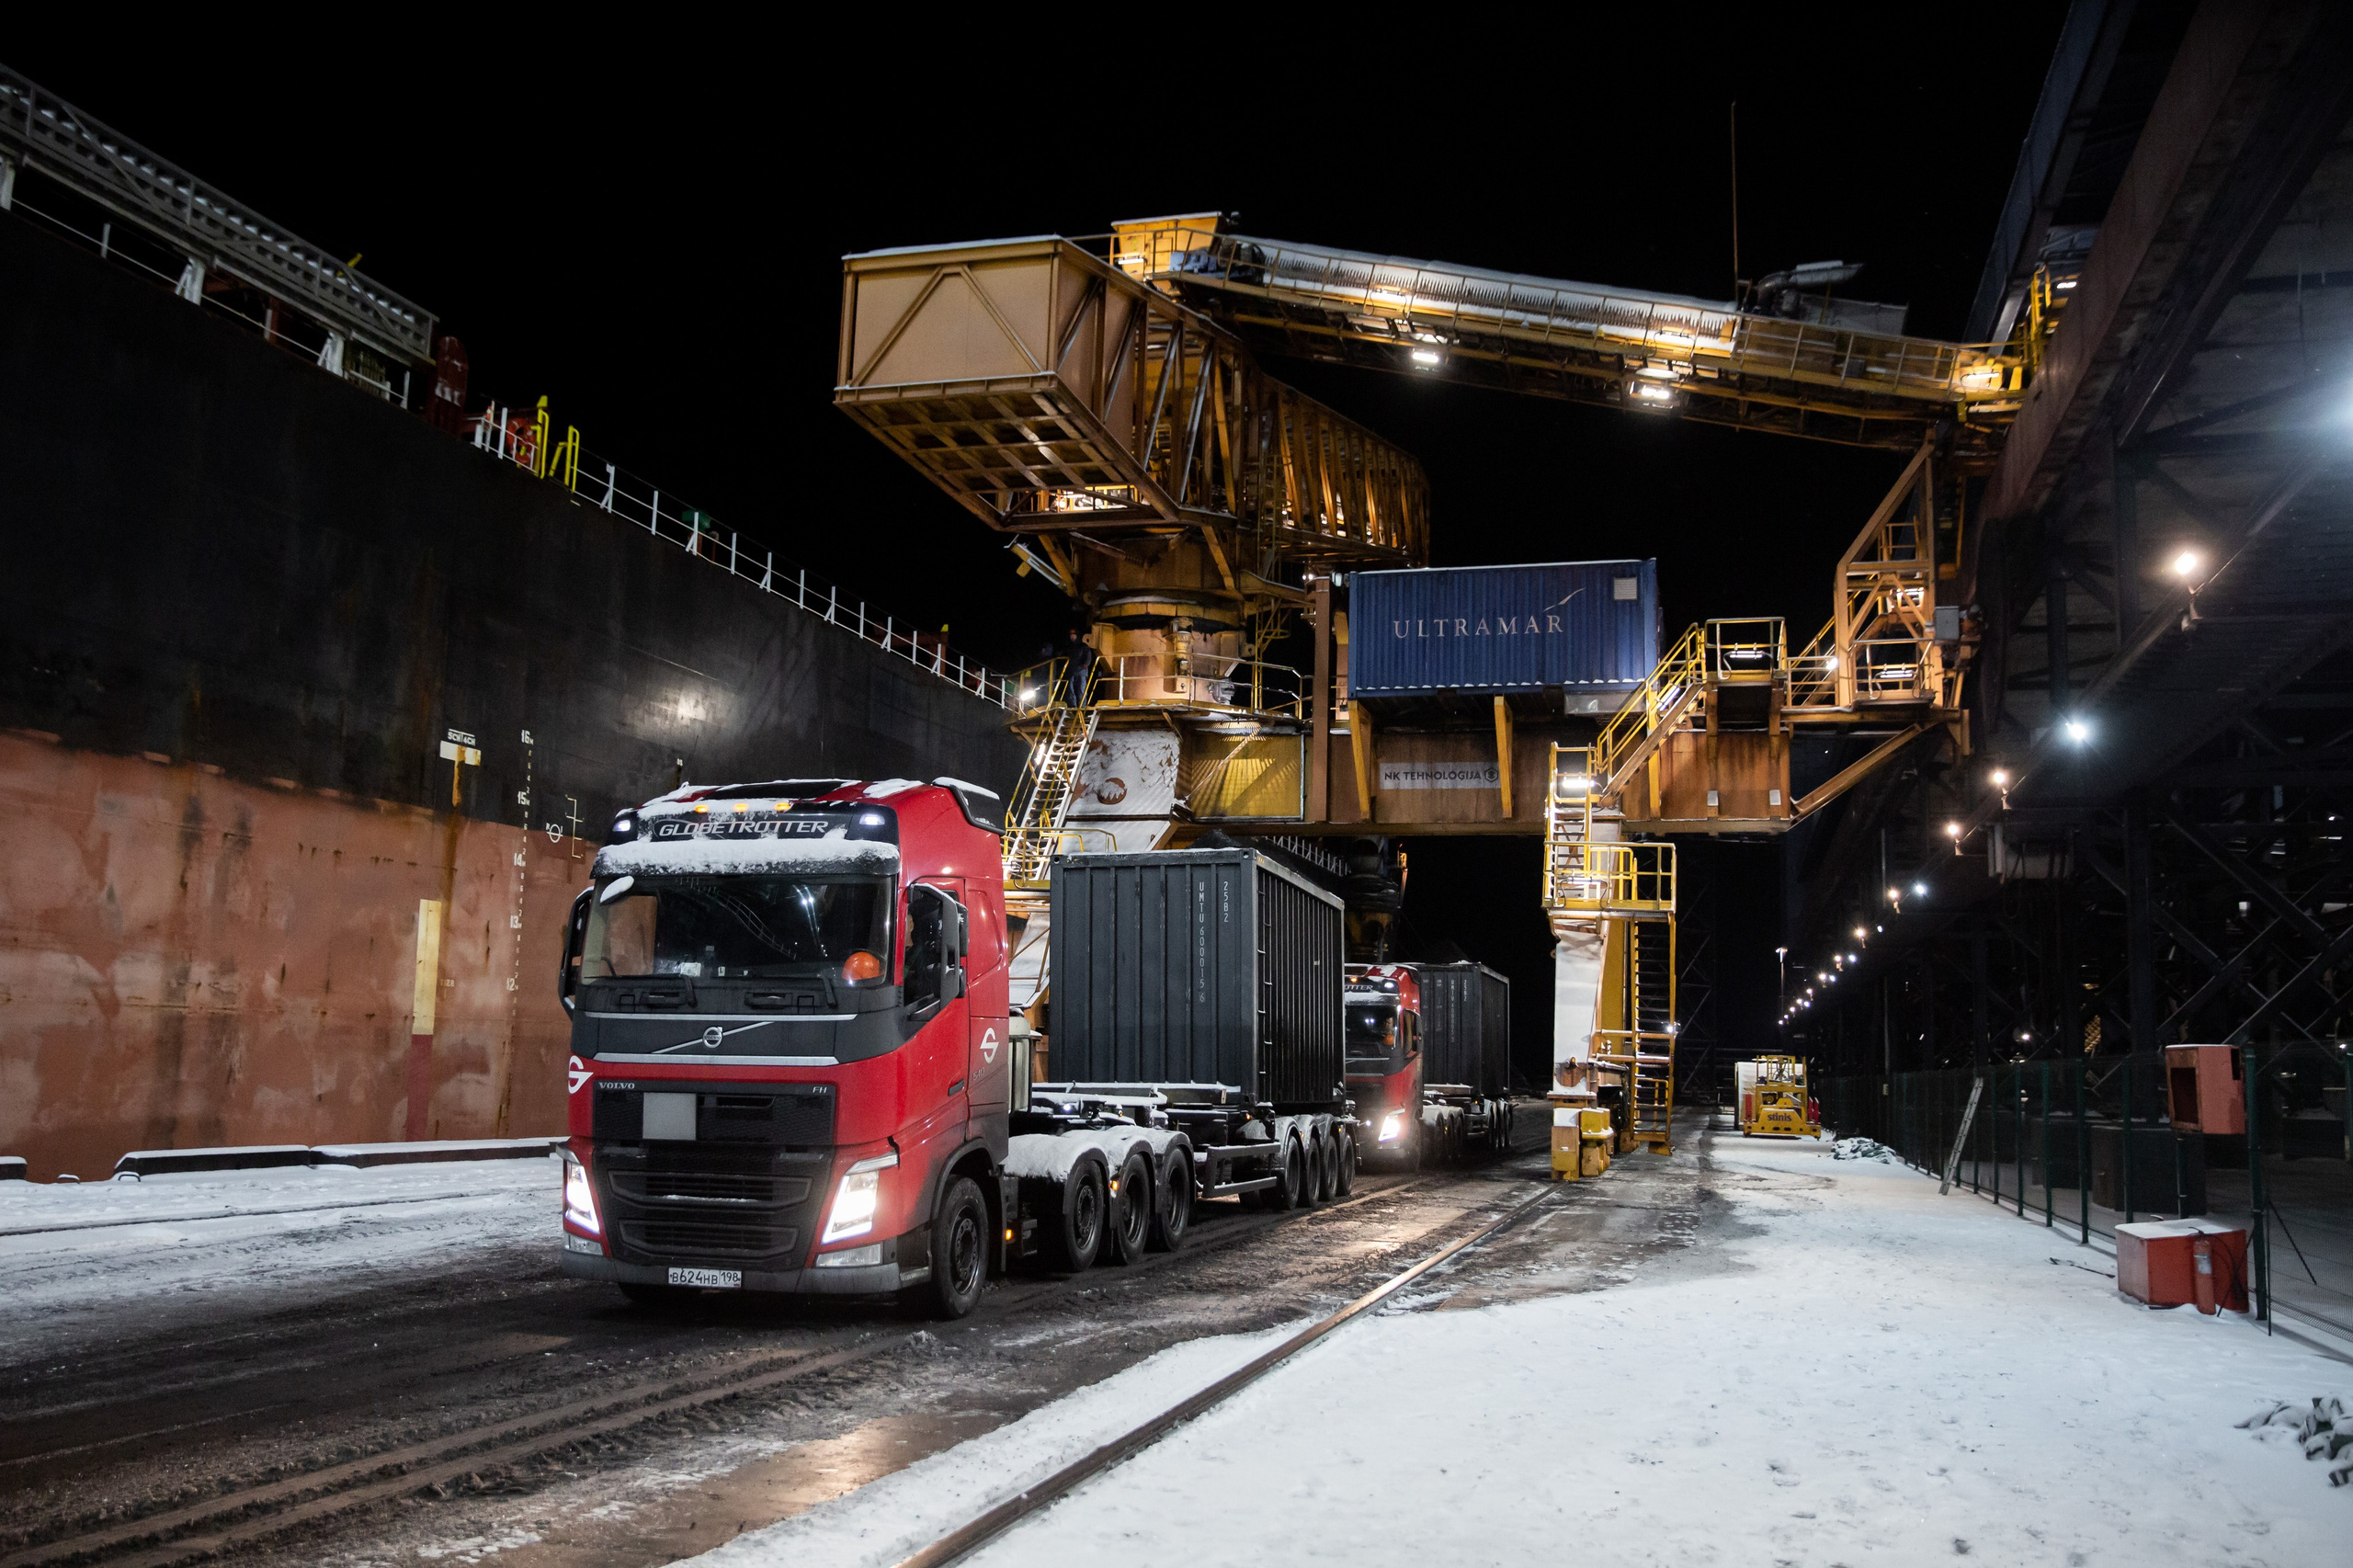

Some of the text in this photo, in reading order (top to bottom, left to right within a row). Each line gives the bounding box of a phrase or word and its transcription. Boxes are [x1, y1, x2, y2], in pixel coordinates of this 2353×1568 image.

[1393, 615, 1563, 639] ULTRAMAR
[1384, 771, 1400, 780] NK
[659, 821, 828, 836] GLOBETROTTER
[598, 1082, 635, 1090] VOLVO
[1768, 1112, 1792, 1121] stinis
[721, 1271, 739, 1282] 198
